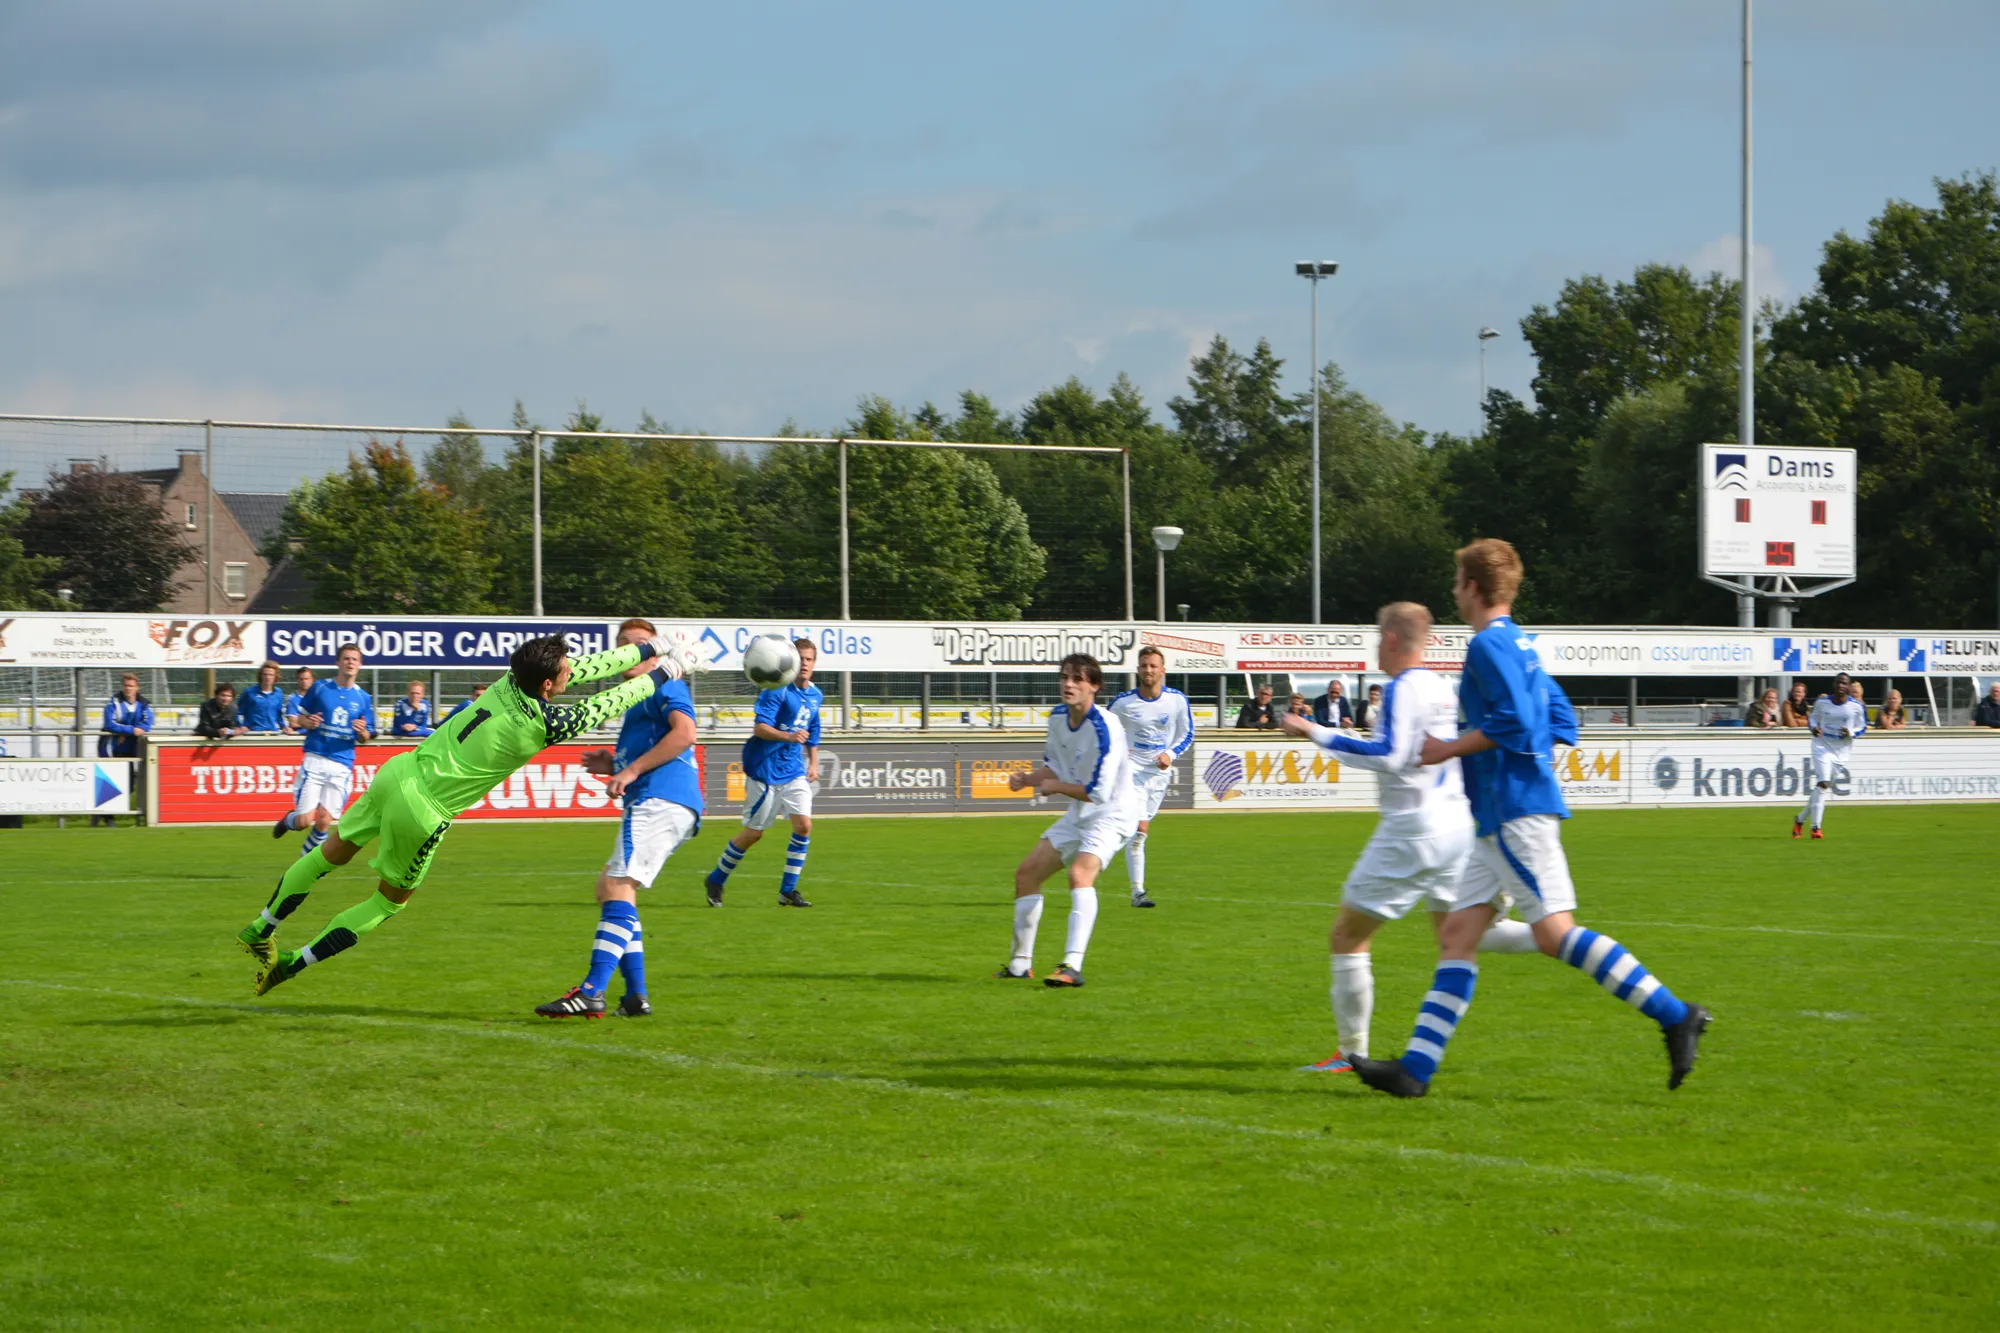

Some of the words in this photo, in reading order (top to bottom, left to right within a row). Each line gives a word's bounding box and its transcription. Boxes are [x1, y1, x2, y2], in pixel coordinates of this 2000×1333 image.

[1768, 455, 1834, 478] Dams
[61, 625, 108, 635] Tubbergen
[164, 620, 253, 648] FOX
[272, 624, 445, 657] SCHRÖDER
[453, 631, 603, 658] CARSH
[821, 628, 872, 655] Glas
[1808, 639, 1876, 655] HELUFIN
[1932, 640, 1999, 656] HELUFIN
[1175, 658, 1229, 669] ALBERGEN
[456, 707, 492, 744] 1
[841, 761, 947, 788] derksen
[1245, 750, 1339, 785] W&M
[1858, 778, 1917, 796] METAL
[1922, 777, 2000, 794] INDUSTR
